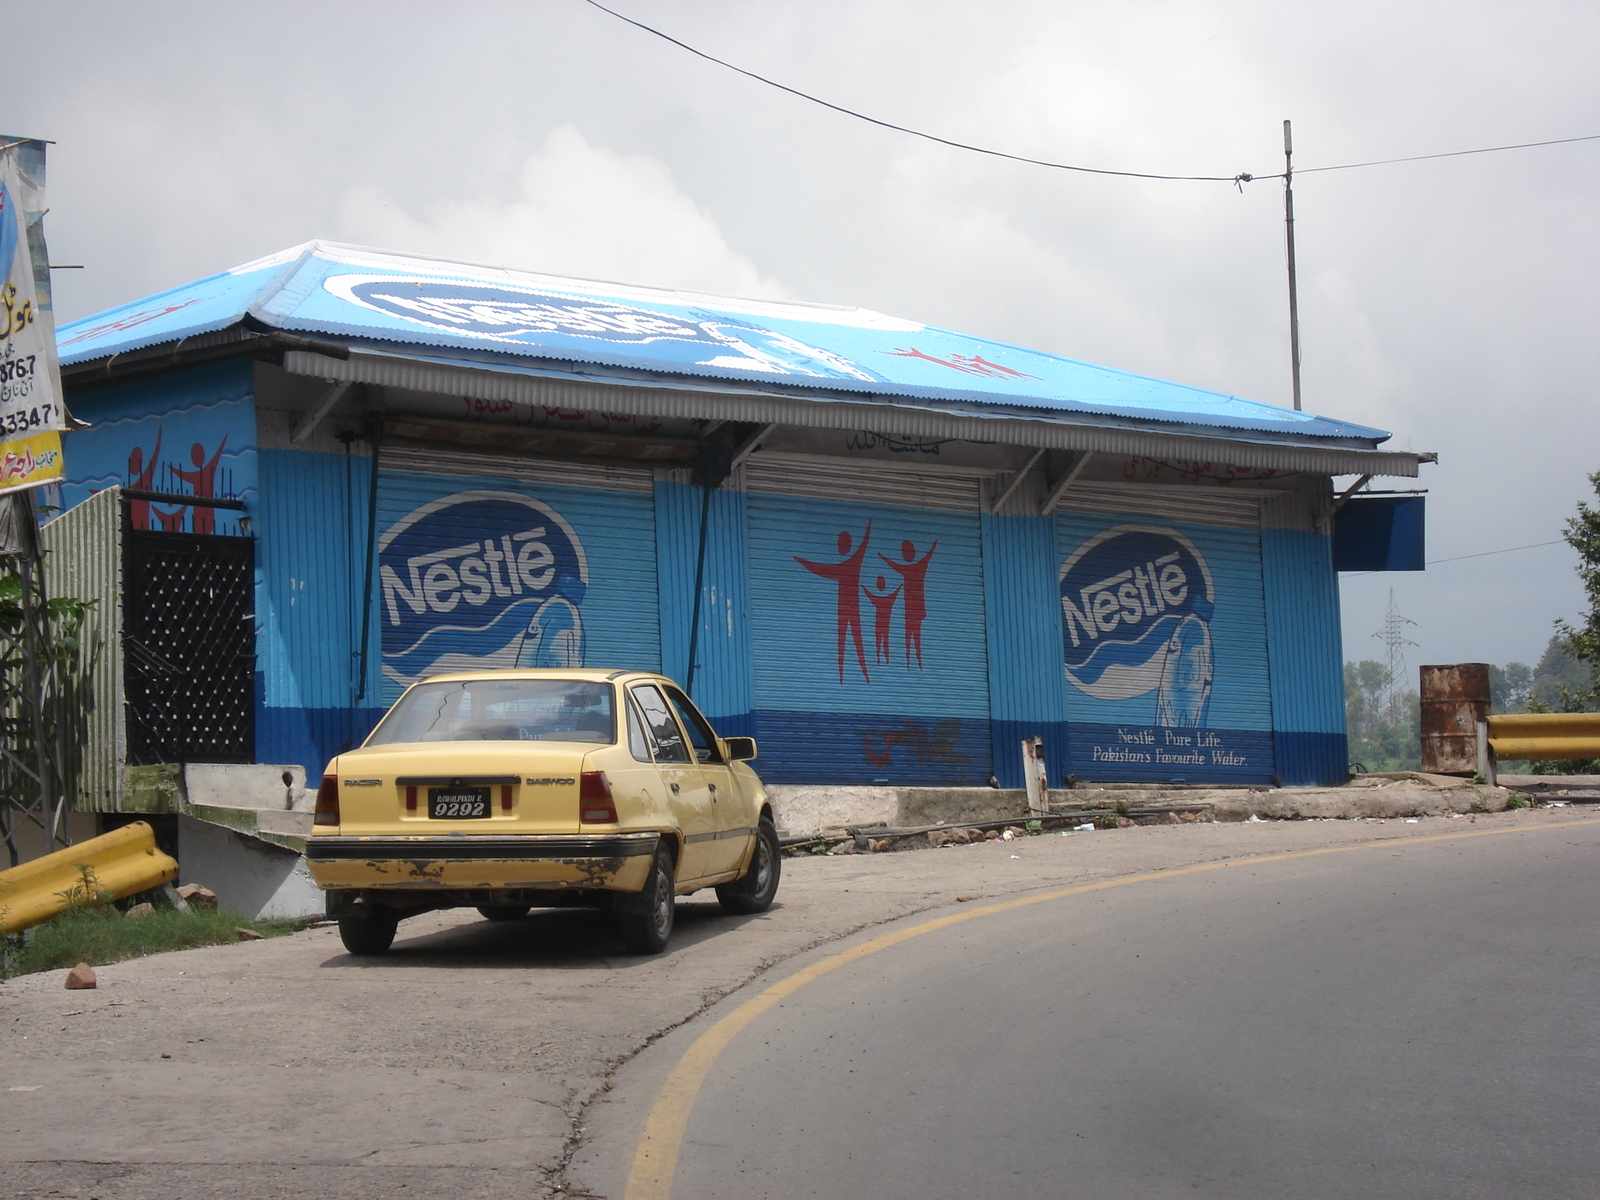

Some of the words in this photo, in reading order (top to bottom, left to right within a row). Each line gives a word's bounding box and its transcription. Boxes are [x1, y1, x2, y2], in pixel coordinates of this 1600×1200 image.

[1165, 730, 1192, 746] Pure
[1155, 748, 1206, 764] Favourite
[344, 778, 383, 787] RACER
[526, 777, 576, 786] DAEWOO
[434, 802, 485, 817] 9292
